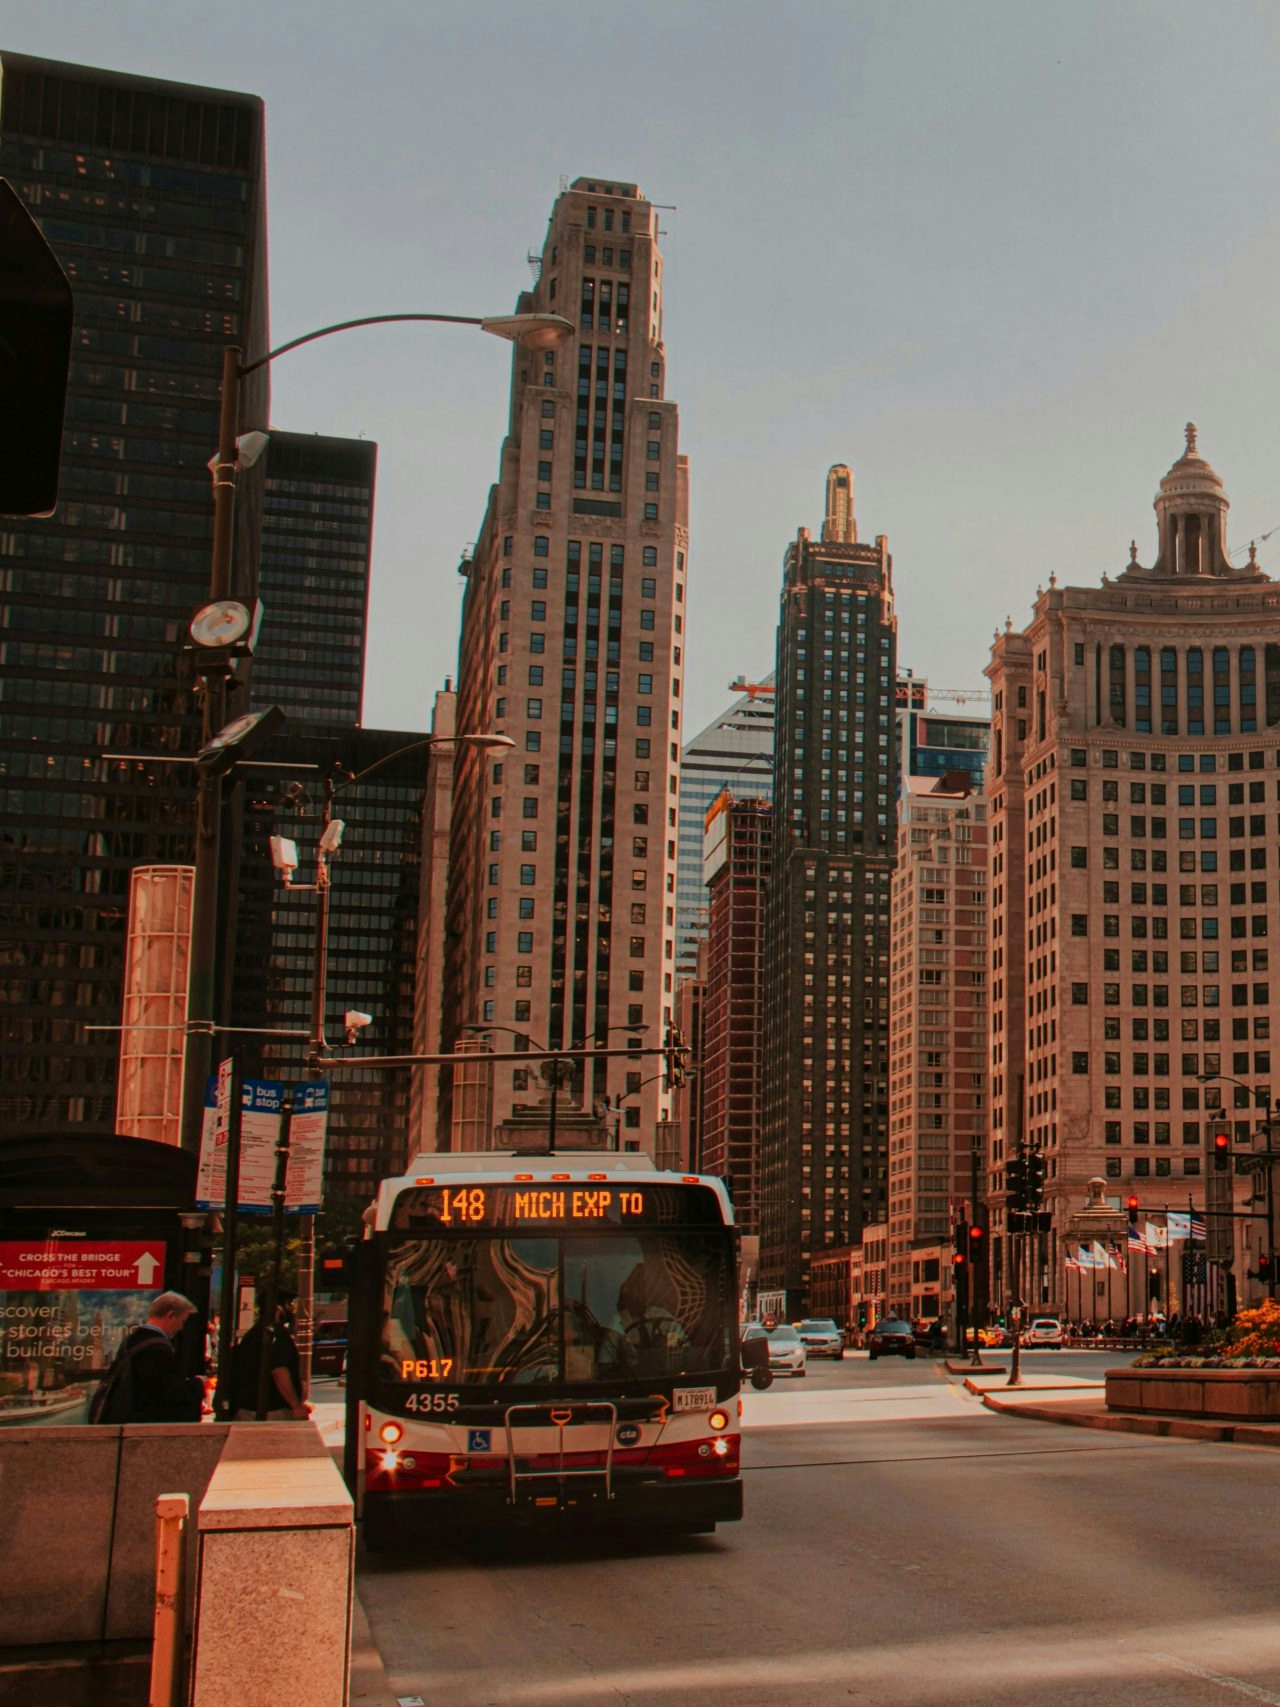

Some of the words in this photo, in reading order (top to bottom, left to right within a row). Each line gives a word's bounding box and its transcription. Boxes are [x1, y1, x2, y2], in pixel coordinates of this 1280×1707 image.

[256, 1086, 277, 1097] bus
[255, 1097, 280, 1110] stop
[440, 1188, 485, 1221] 148
[515, 1191, 565, 1218] MICH
[572, 1191, 611, 1217] EXP
[619, 1193, 643, 1214] TO
[19, 1253, 55, 1262] CROSS
[58, 1253, 78, 1262] THE
[81, 1253, 121, 1262] BRIDGE
[72, 1269, 98, 1278] BEST
[9, 1321, 73, 1338] stories
[402, 1358, 453, 1379] P617
[405, 1393, 460, 1412] 4355
[620, 1430, 637, 1439] cta
